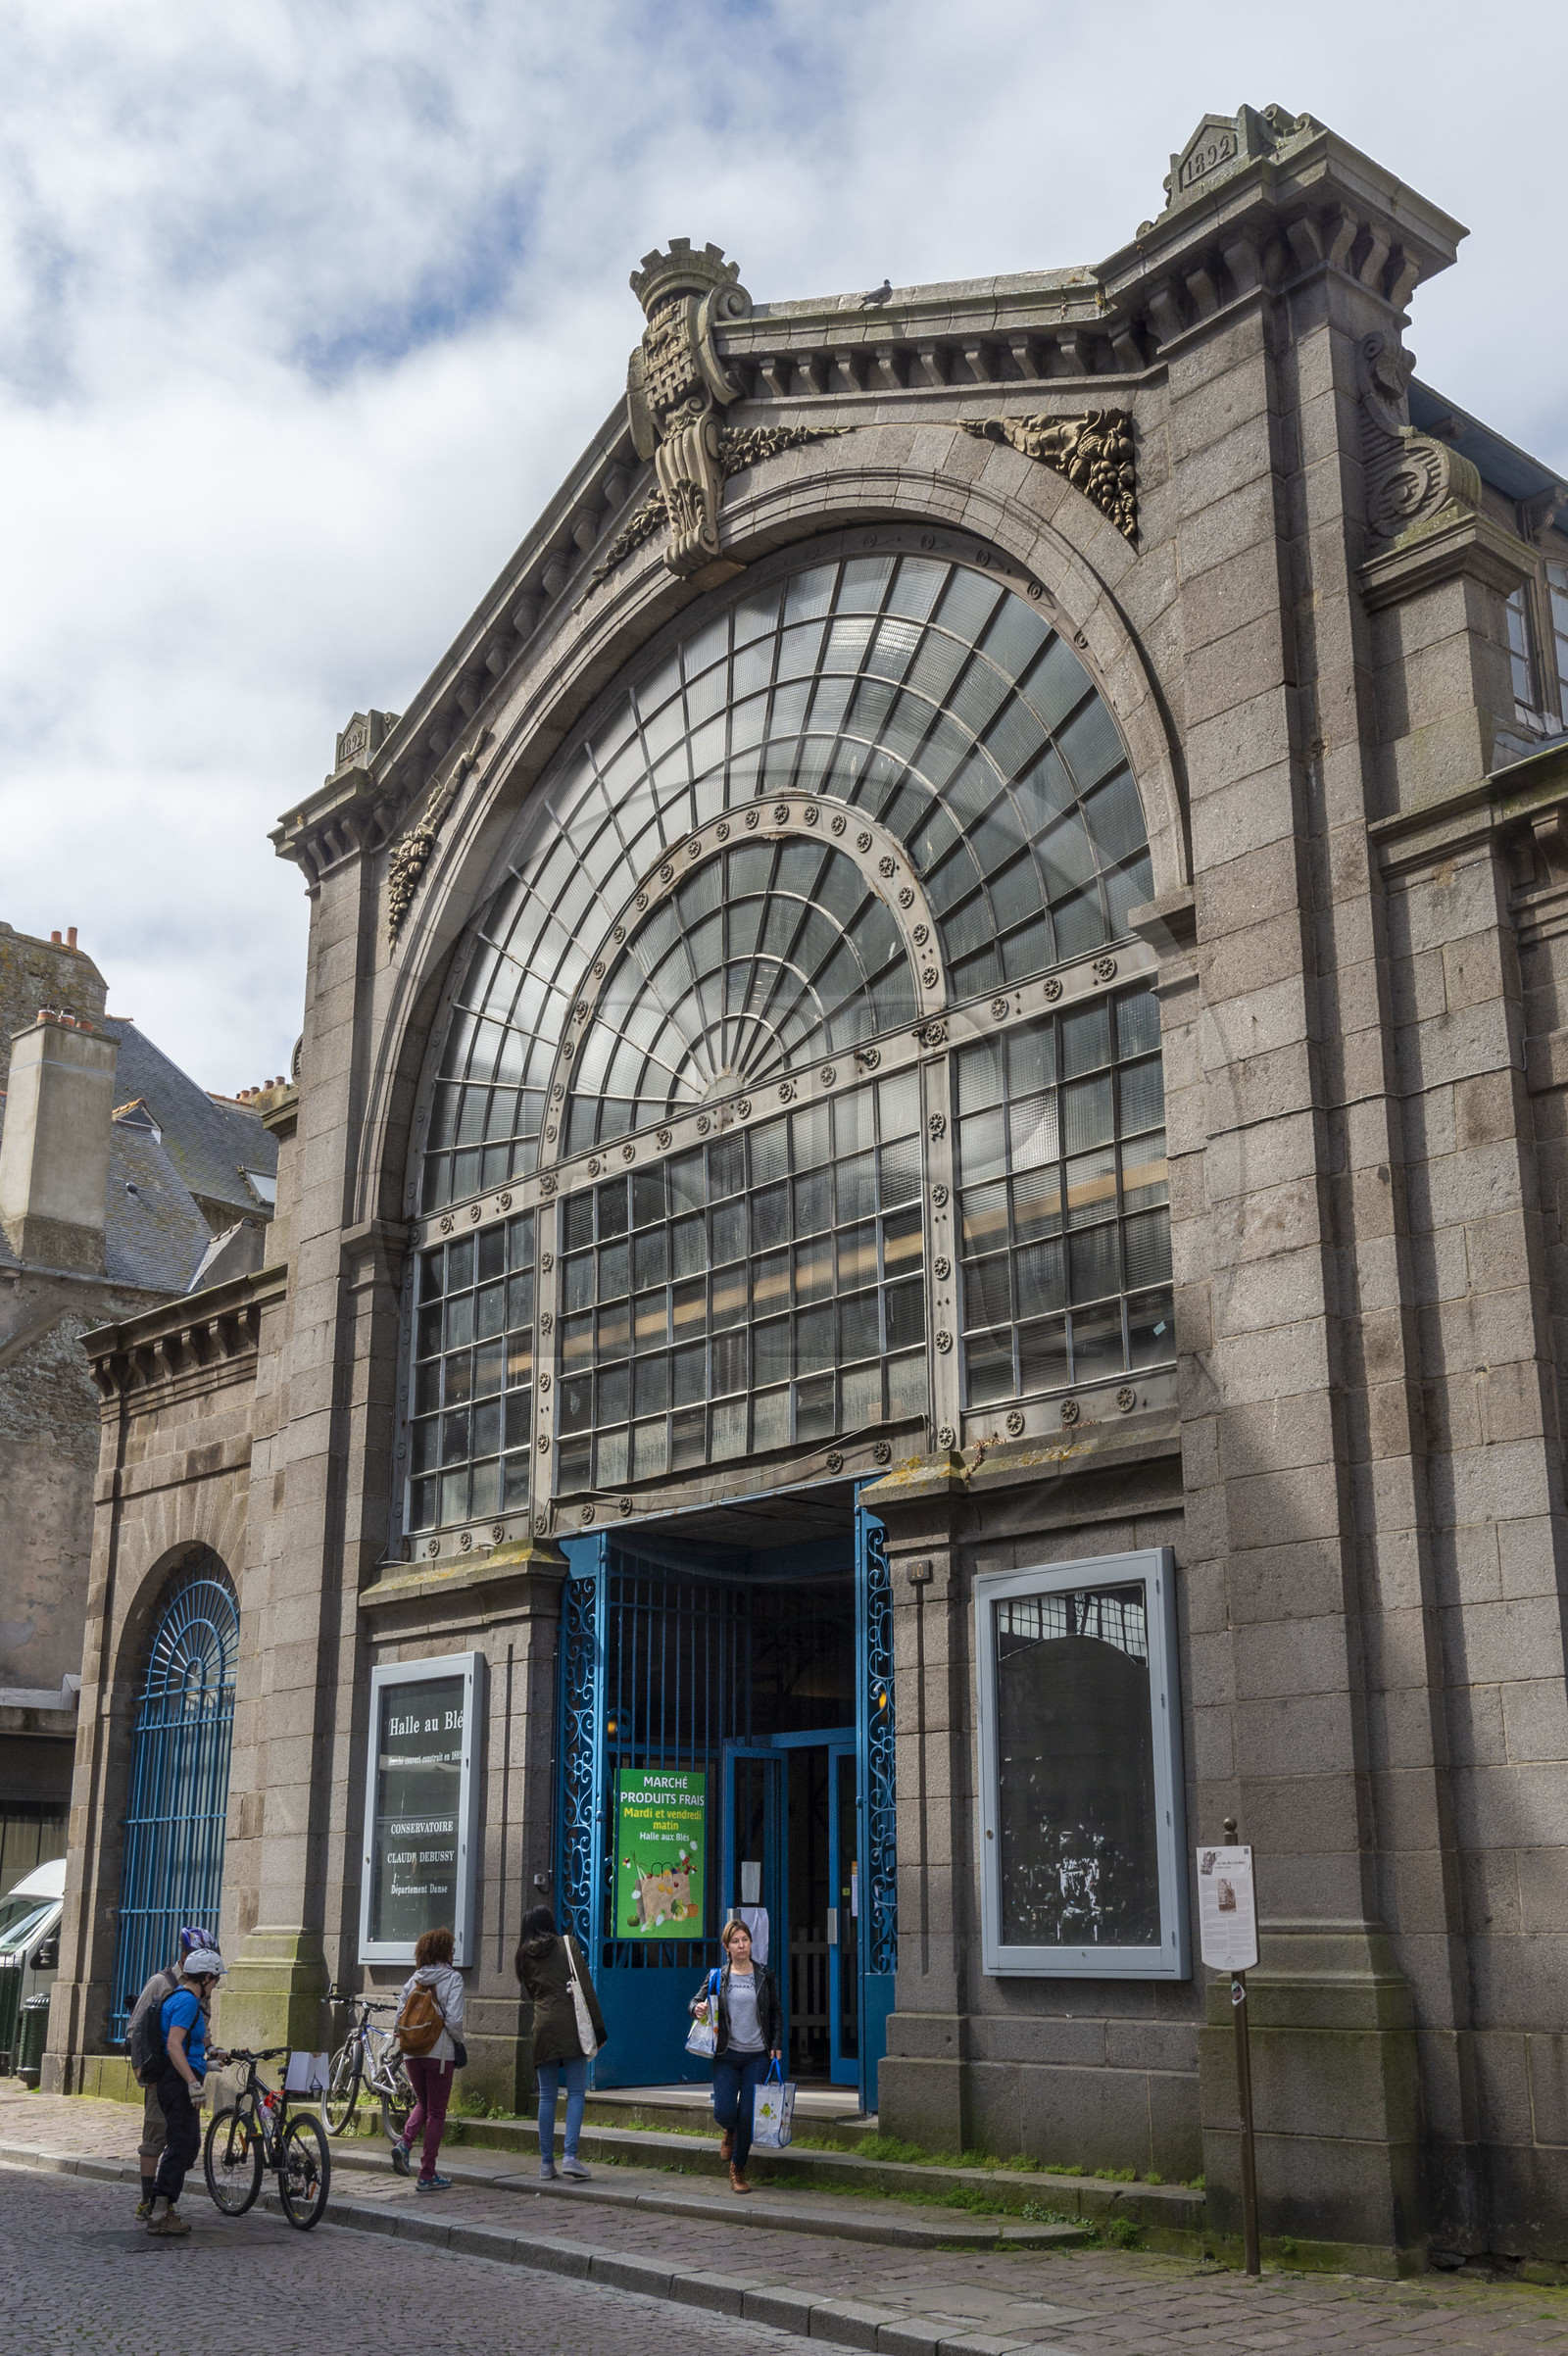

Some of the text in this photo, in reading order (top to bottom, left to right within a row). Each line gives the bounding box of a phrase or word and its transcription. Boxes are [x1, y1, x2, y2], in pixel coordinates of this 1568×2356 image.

[1188, 134, 1230, 180] 1892
[342, 730, 363, 758] 1892
[911, 1563, 923, 1579] 10
[389, 1709, 464, 1736] Halle au Blé
[643, 1776, 688, 1789] MARCHÉ
[620, 1792, 705, 1806] PRODUITS FRAIS
[623, 1807, 702, 1820] Mardi et vendredi
[390, 1821, 454, 1835] CONSERVATOIRE
[653, 1820, 679, 1831] matin
[639, 1832, 660, 1841] Halle
[675, 1833, 690, 1841] Blés
[419, 1850, 455, 1862] DEBUSSY
[391, 1883, 448, 1896] Département Danse
